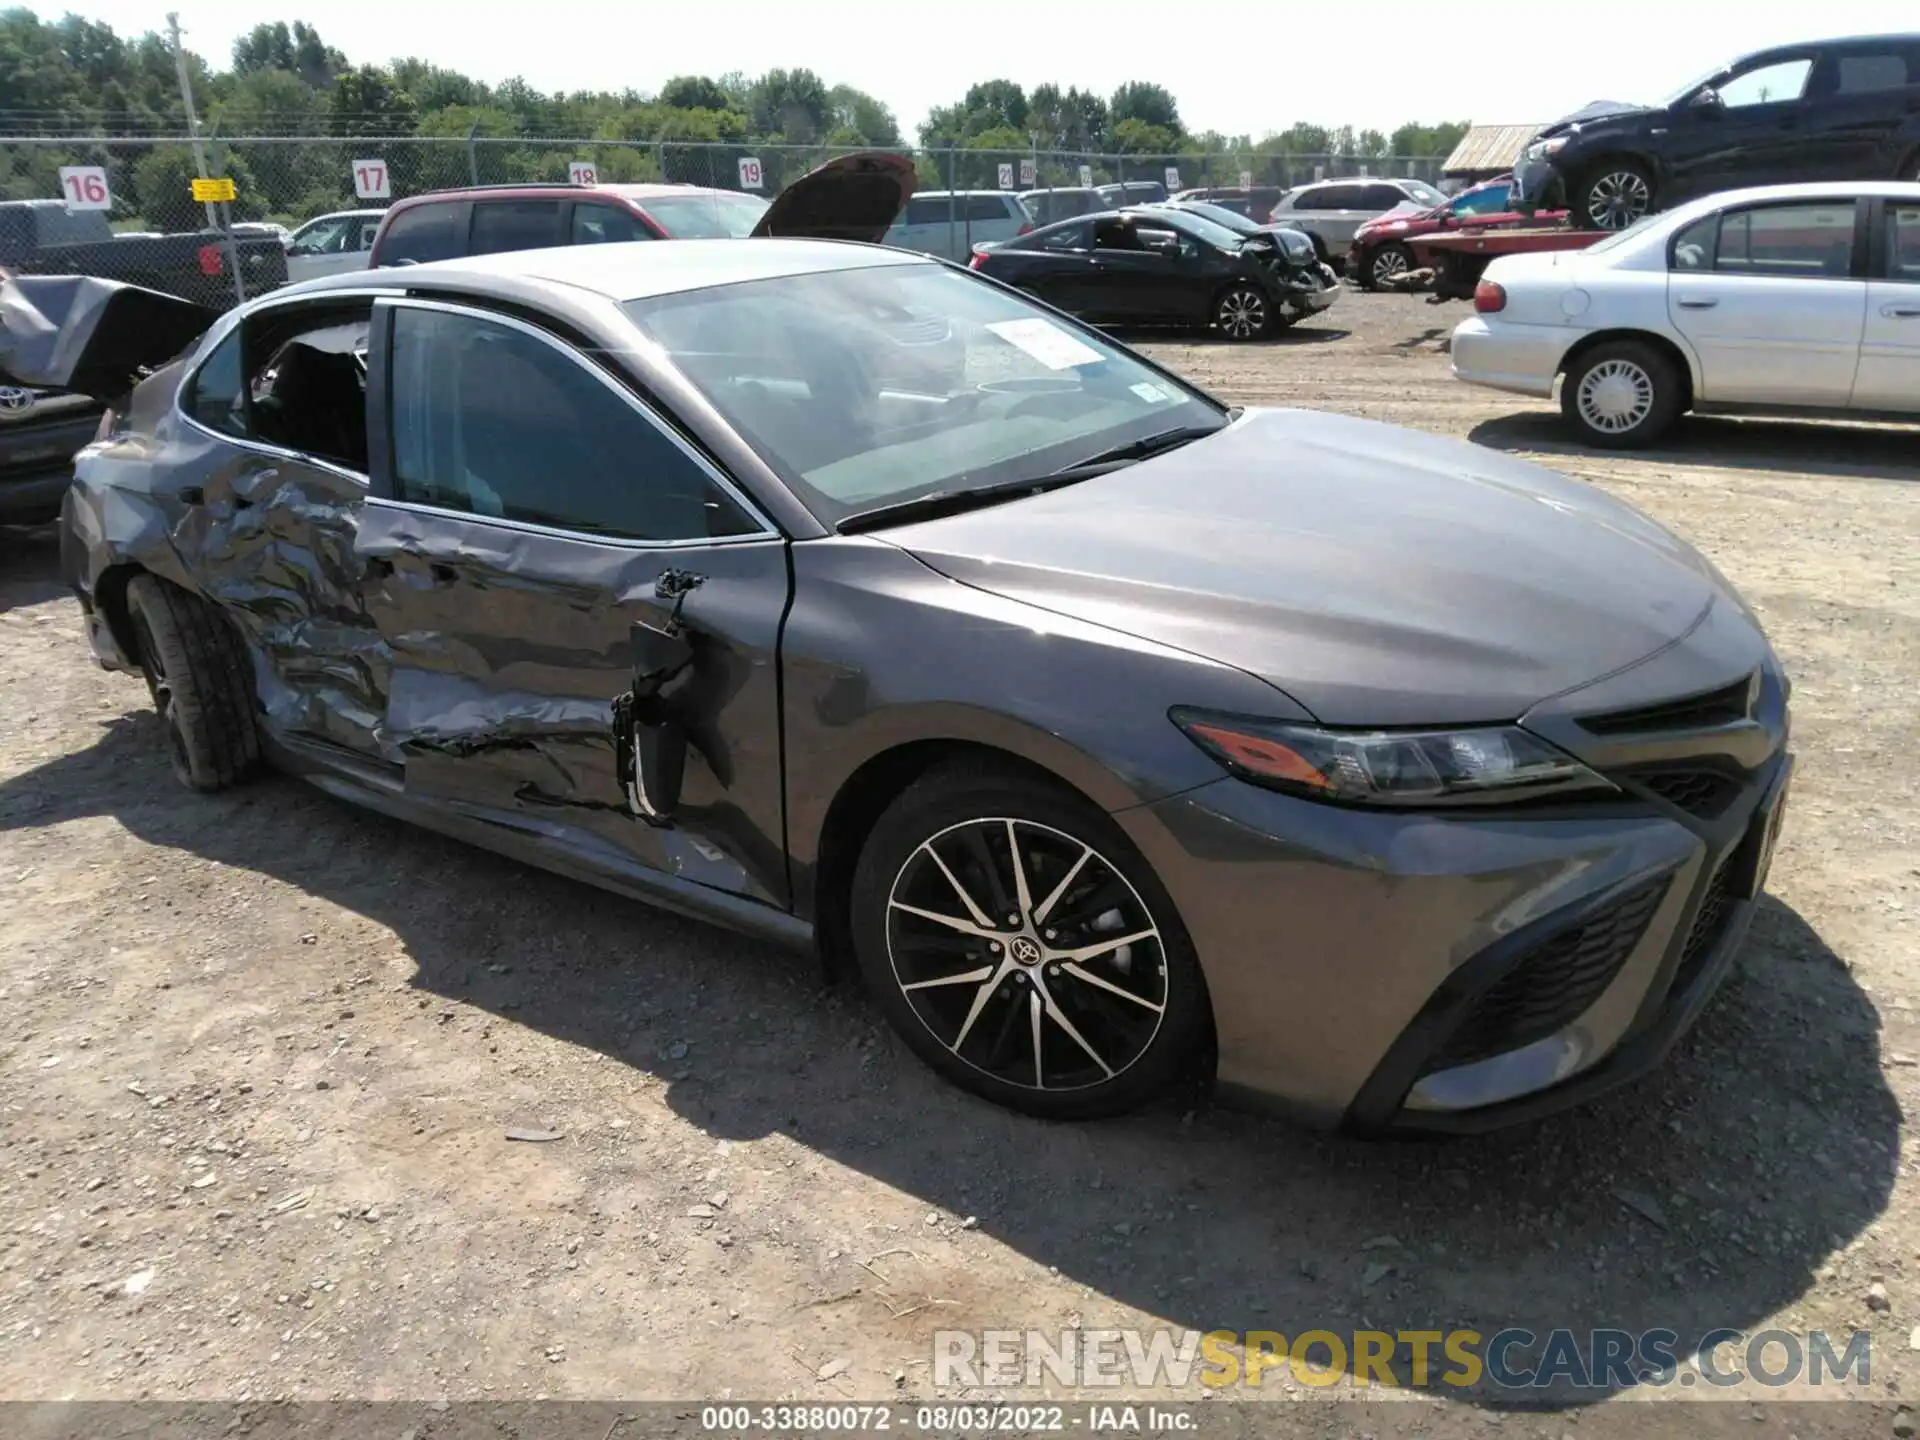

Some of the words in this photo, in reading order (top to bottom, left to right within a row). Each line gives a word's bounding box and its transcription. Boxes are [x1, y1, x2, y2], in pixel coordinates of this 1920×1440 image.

[357, 167, 383, 192] 17
[742, 163, 760, 183] 19
[65, 174, 105, 203] 16
